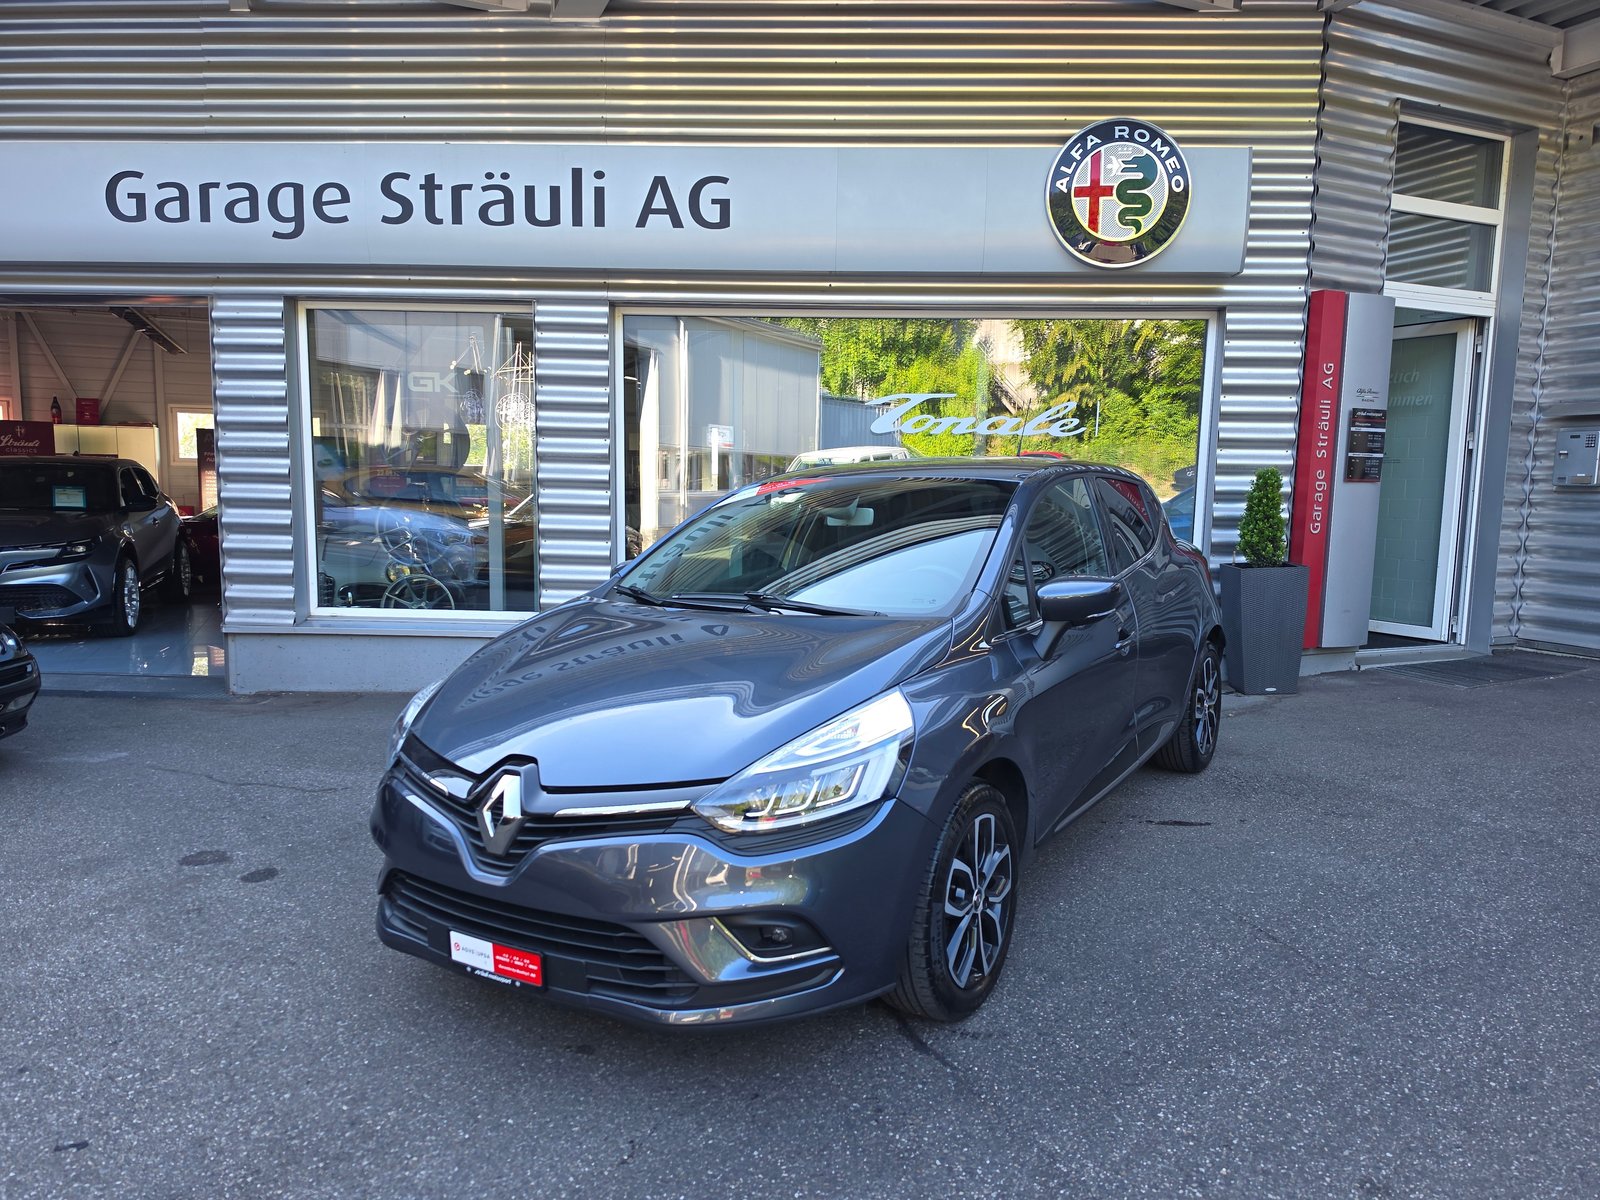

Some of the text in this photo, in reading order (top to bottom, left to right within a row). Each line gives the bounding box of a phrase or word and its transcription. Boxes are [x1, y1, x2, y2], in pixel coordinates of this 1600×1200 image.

[1056, 126, 1185, 194] ALFA ROMEO
[105, 167, 731, 240] Garage Sträuli AG
[408, 371, 459, 393] GK
[865, 393, 1087, 437] Tonale
[1310, 362, 1335, 534] Garage Sträuli AG
